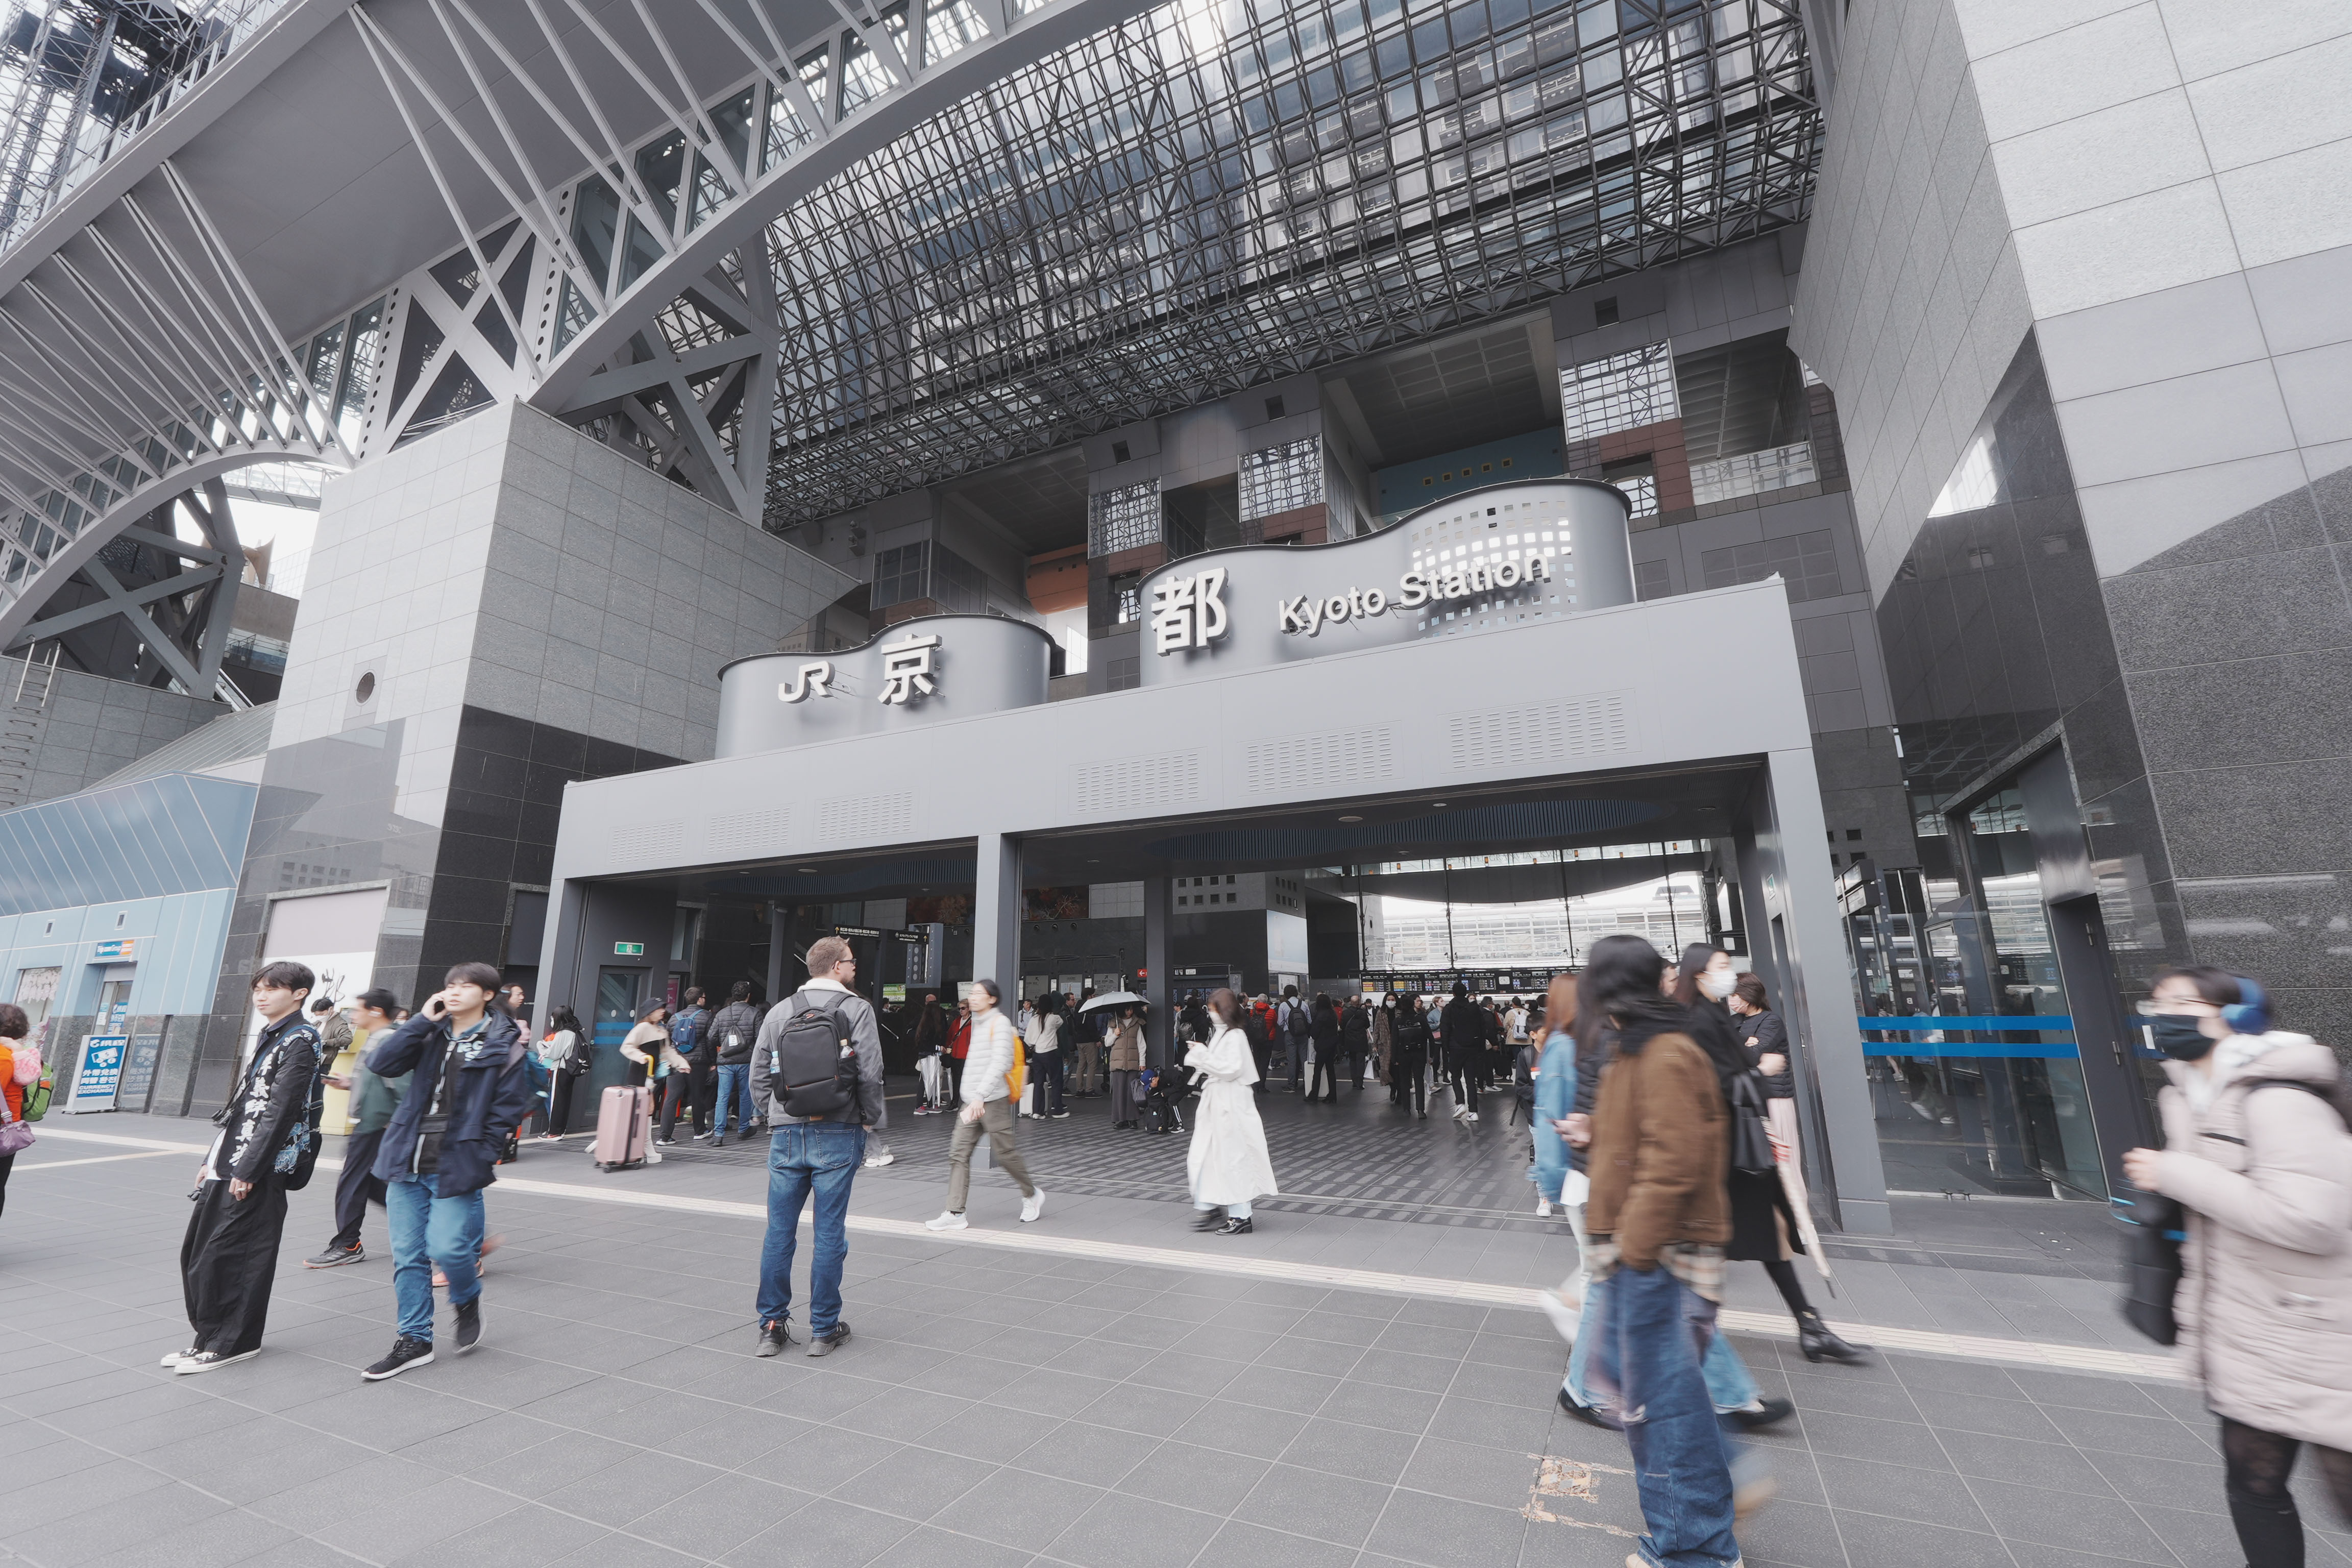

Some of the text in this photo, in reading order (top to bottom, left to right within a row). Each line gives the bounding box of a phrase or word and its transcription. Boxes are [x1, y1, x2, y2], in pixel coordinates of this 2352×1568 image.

[1150, 567, 1229, 657] 都
[1279, 553, 1551, 638] Kyoto Station
[778, 660, 835, 703] JR
[877, 633, 942, 705] 京
